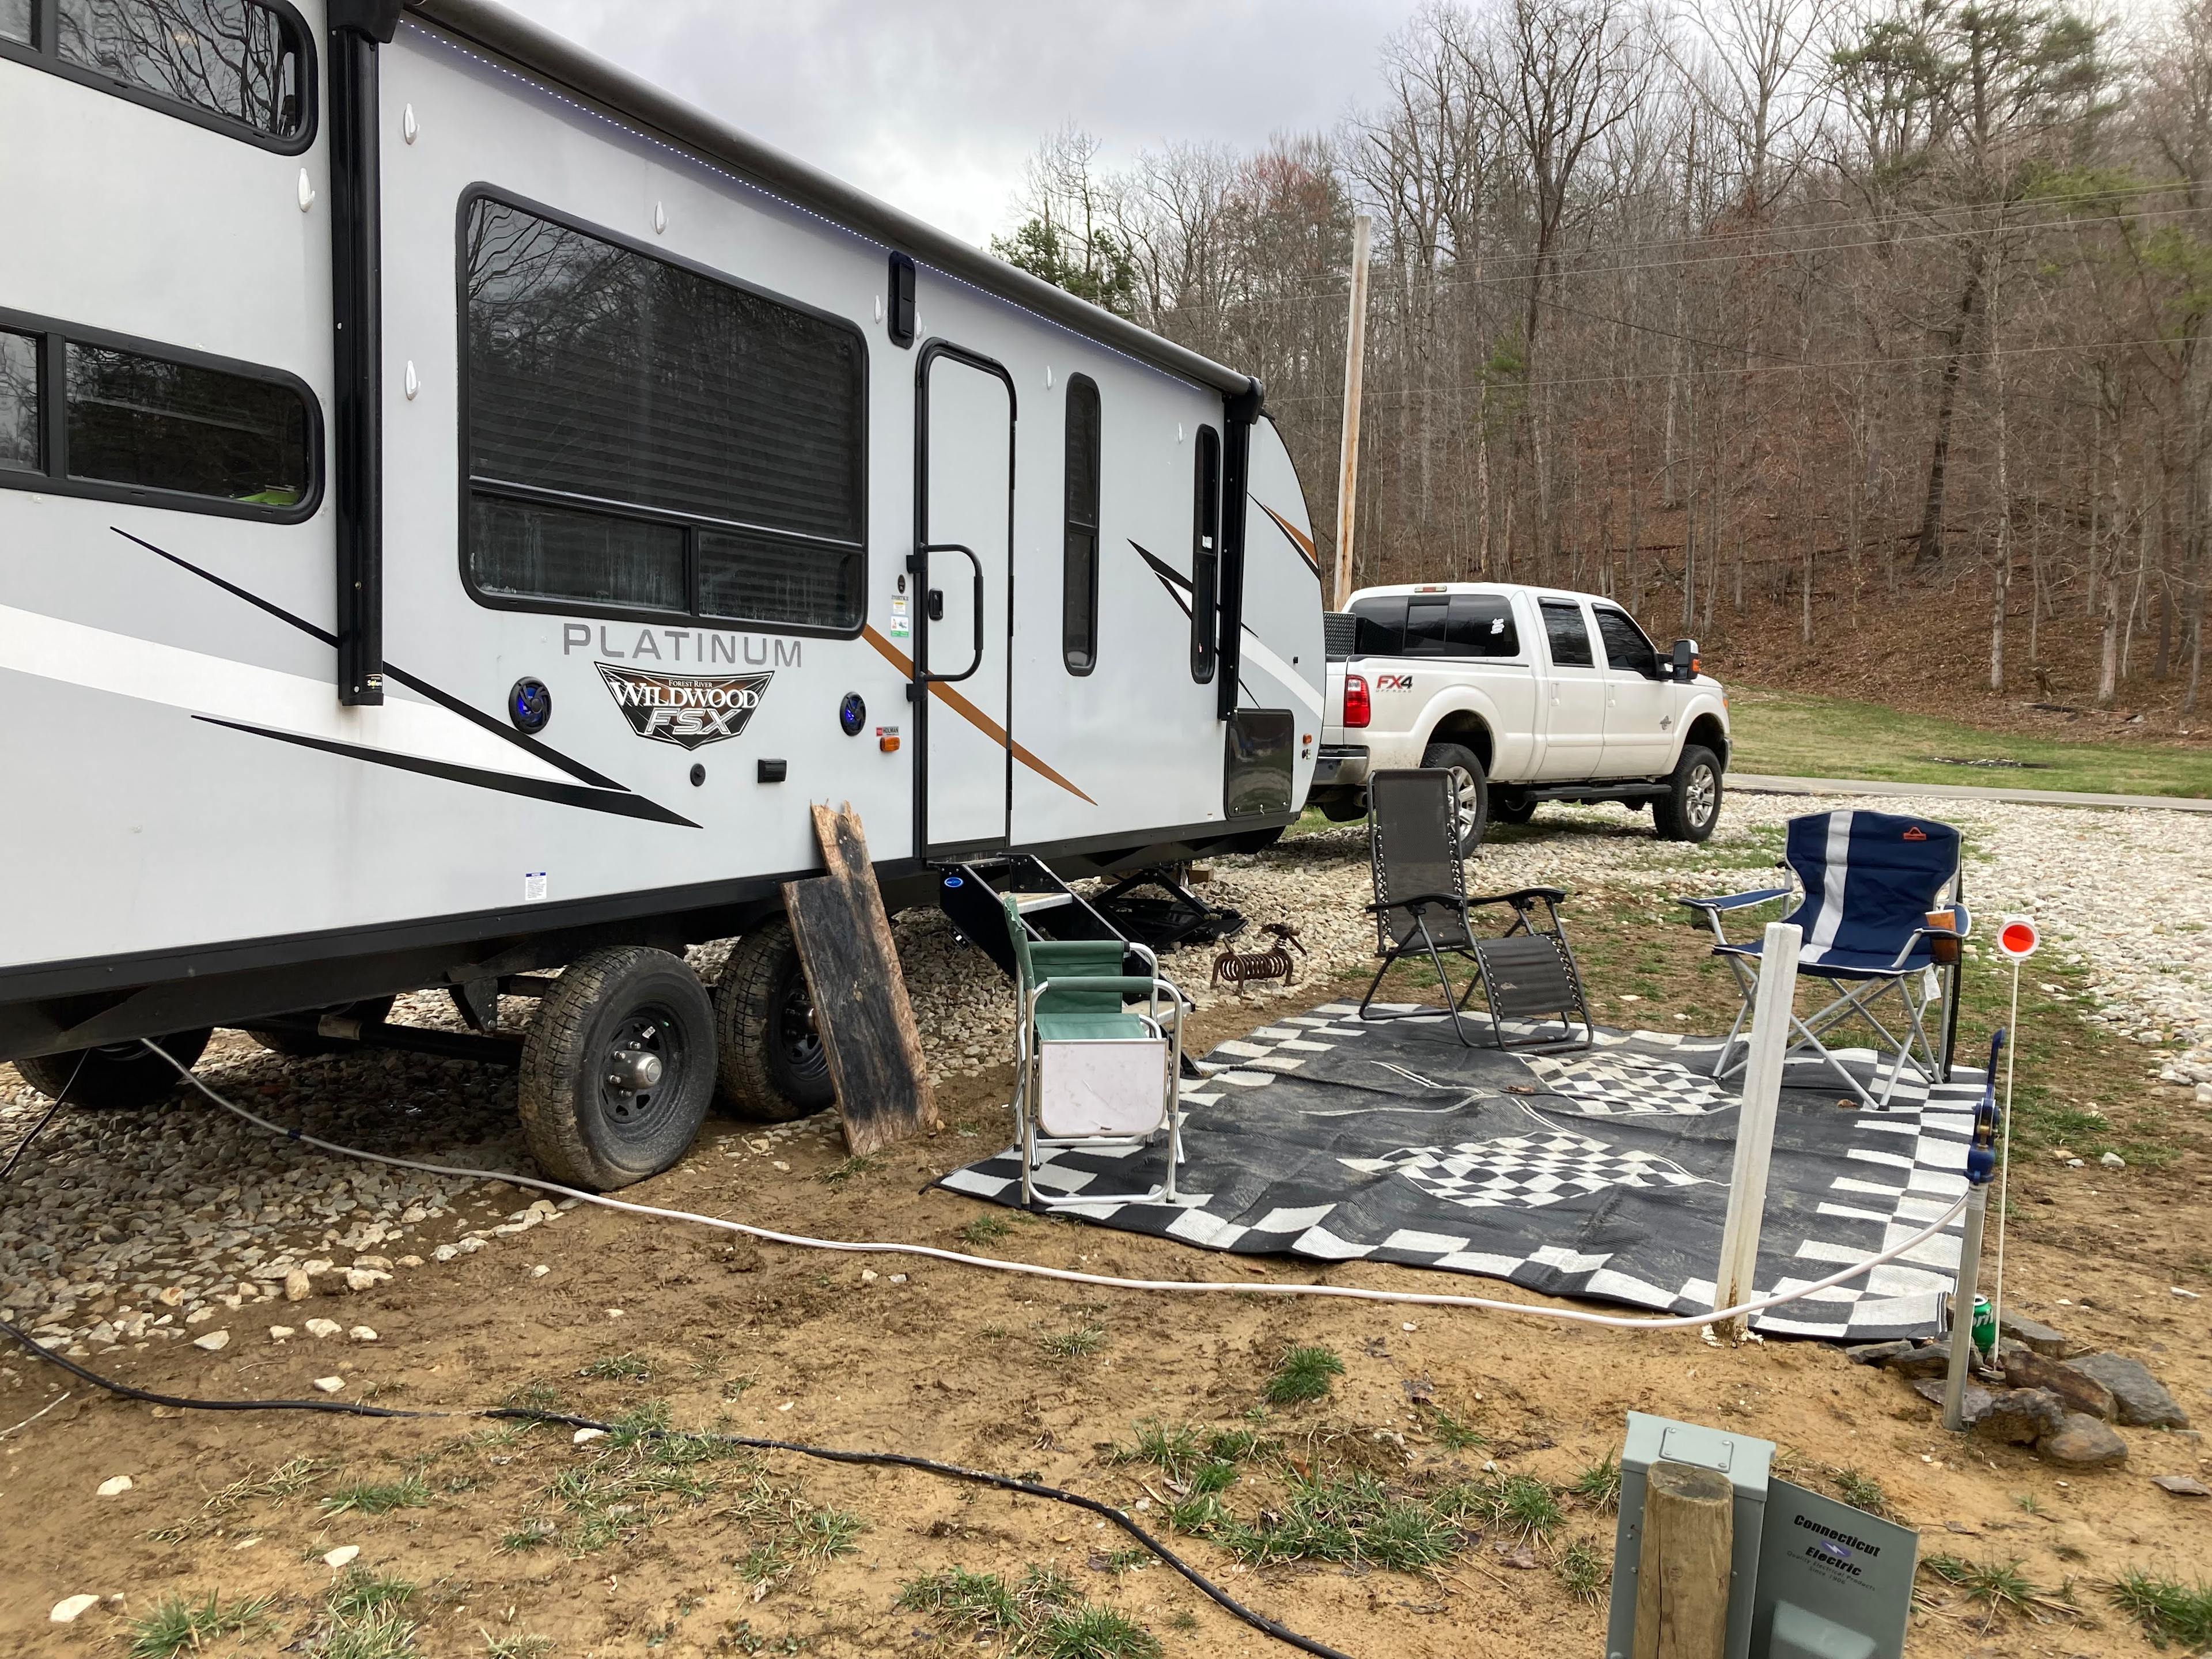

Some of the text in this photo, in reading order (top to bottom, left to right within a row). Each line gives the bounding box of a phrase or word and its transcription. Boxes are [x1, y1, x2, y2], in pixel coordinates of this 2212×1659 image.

[563, 623, 801, 668] PLATINUM
[609, 681, 759, 709] WILDWOOD
[694, 680, 713, 688] RIVER
[1376, 674, 1413, 689] FX4
[643, 707, 742, 735] FSX
[1794, 1514, 1881, 1557] Connecticut
[1787, 1550, 1876, 1592] Quality Electrical Products
[1805, 1546, 1862, 1576] Electric
[1808, 1566, 1846, 1585] Since 1906
